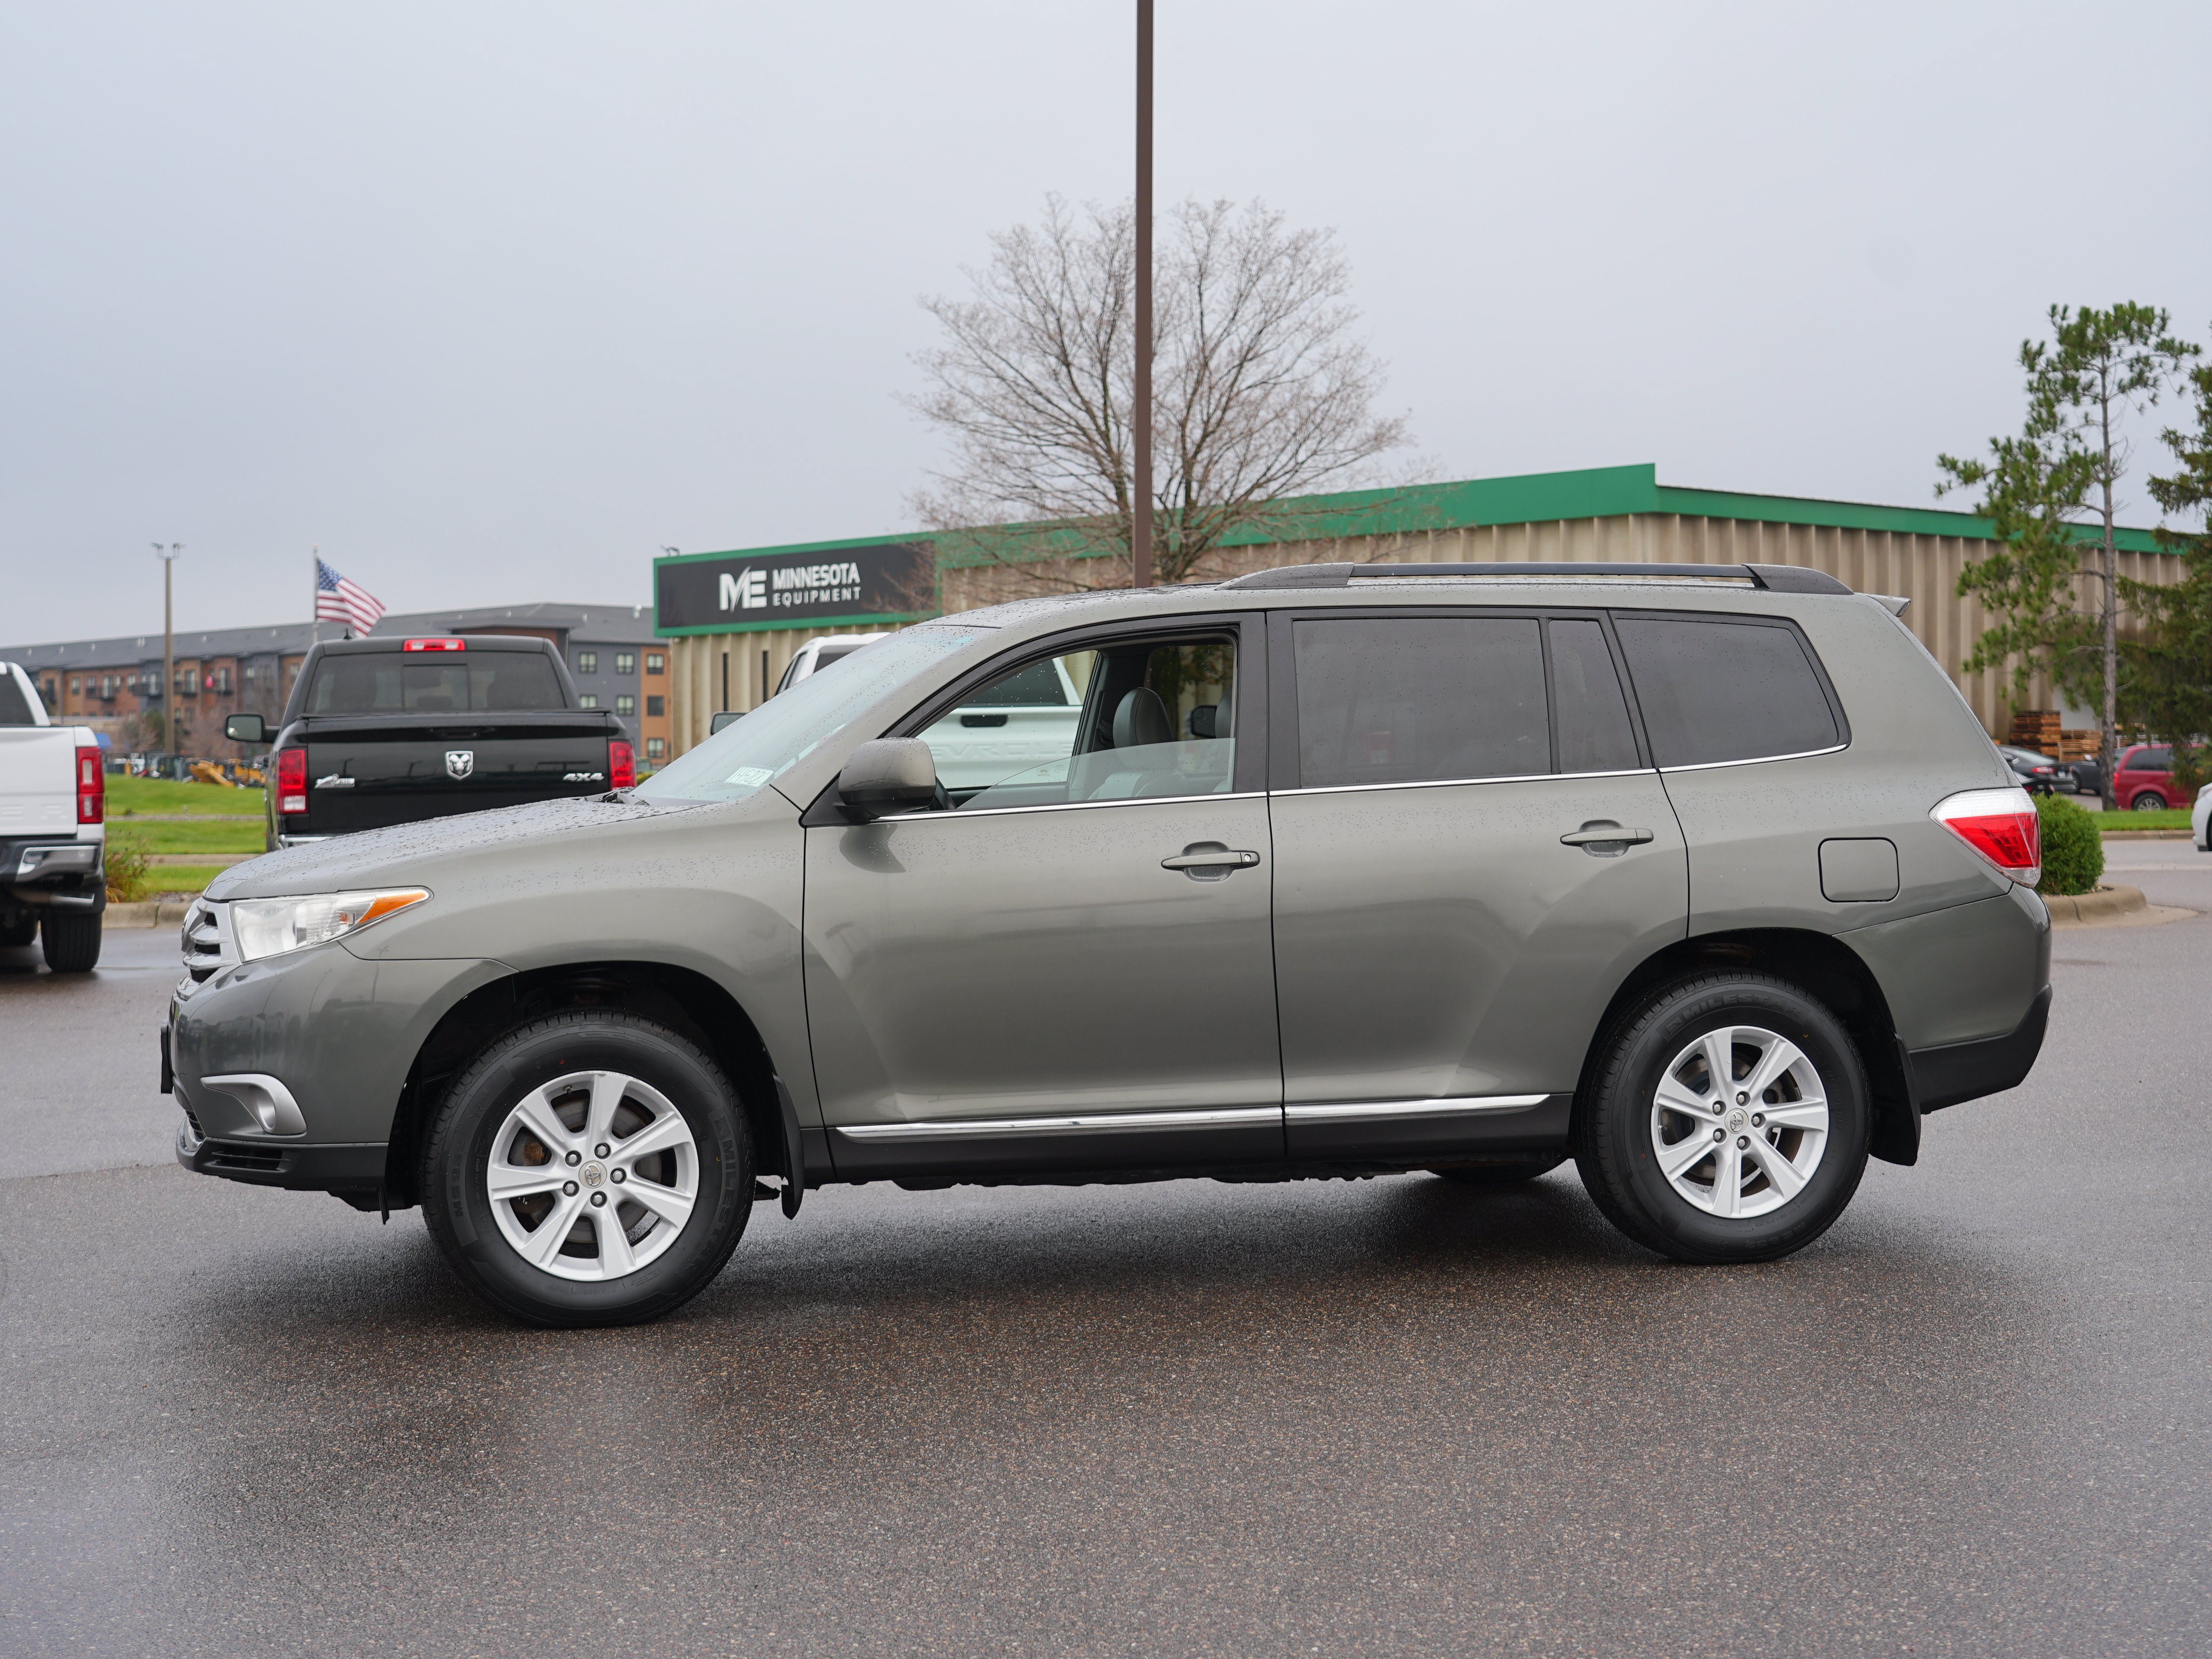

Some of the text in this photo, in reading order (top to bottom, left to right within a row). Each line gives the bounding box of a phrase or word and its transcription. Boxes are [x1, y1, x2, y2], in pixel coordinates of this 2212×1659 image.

[719, 565, 767, 612] ME
[772, 562, 861, 590] MINNESOTA
[772, 586, 862, 608] EQUIPMENT
